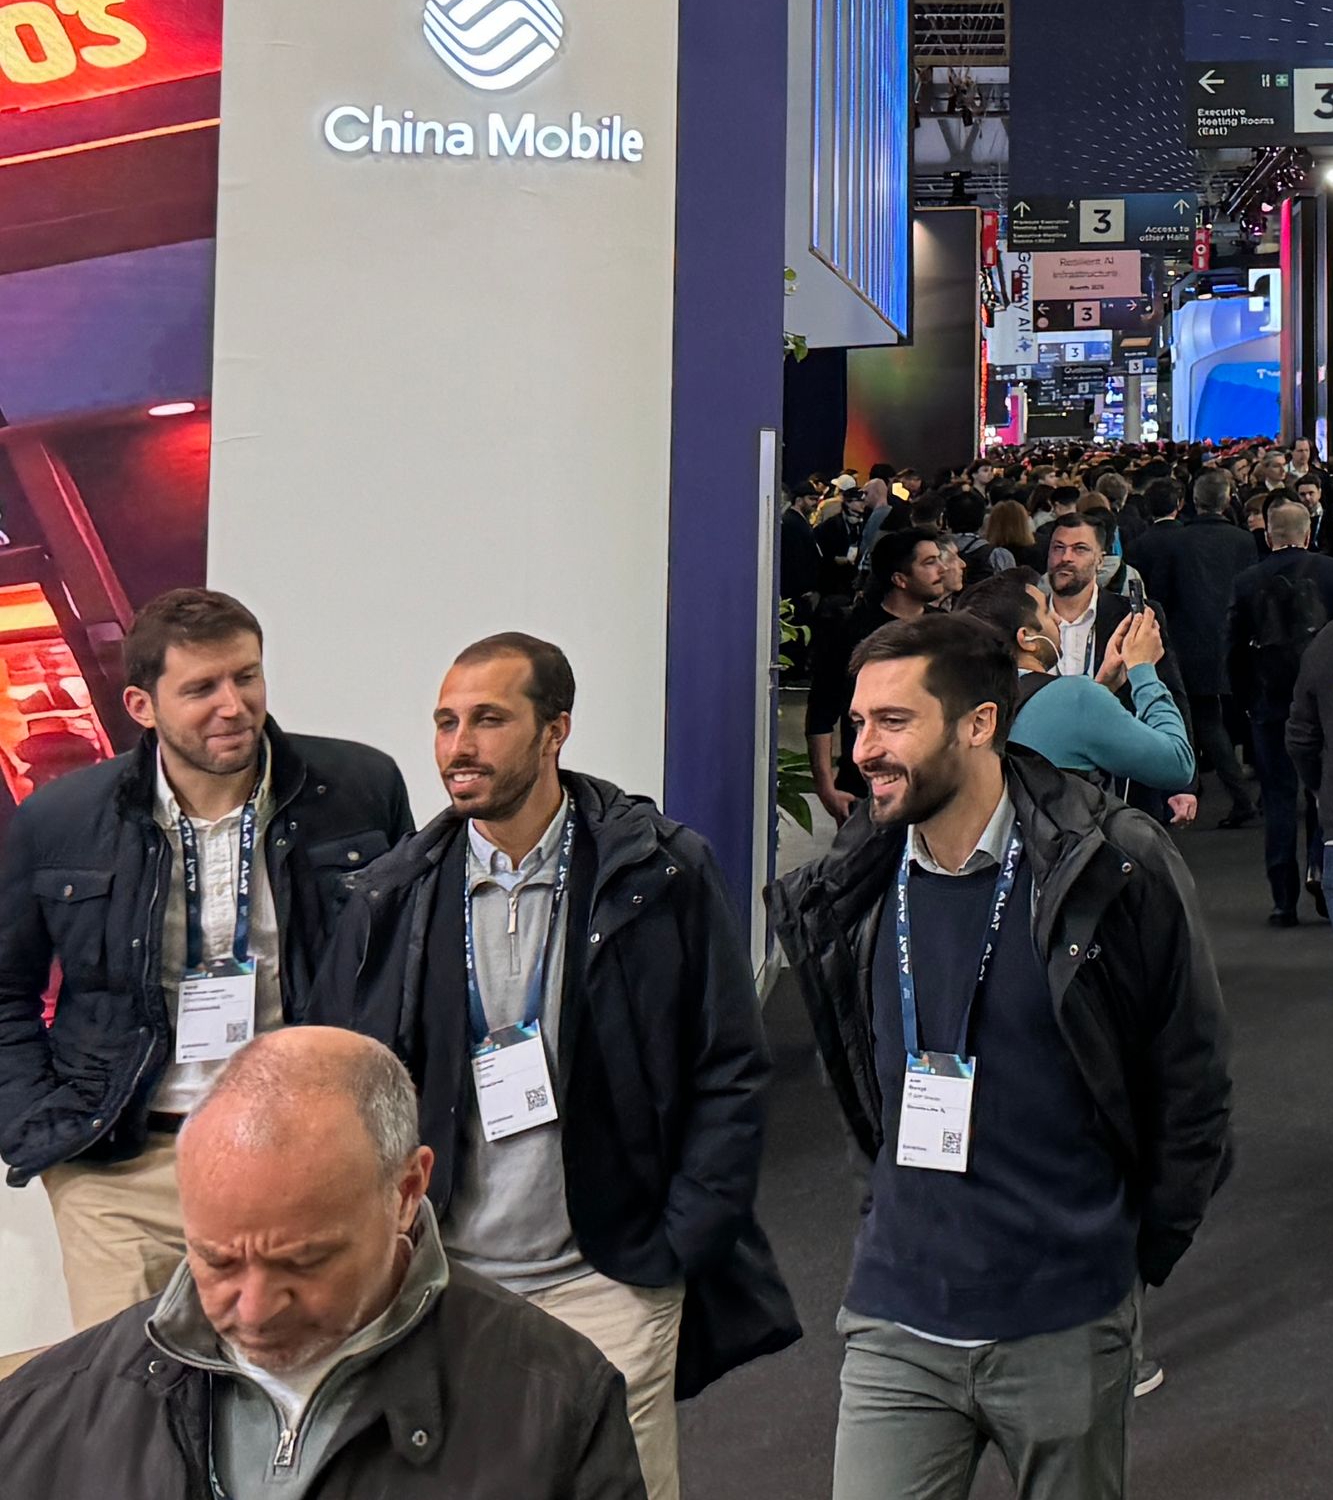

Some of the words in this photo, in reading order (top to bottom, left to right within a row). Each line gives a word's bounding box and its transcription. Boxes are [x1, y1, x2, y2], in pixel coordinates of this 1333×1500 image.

[324, 105, 474, 156] China
[488, 111, 645, 162] Mobile
[1093, 209, 1112, 233] 3
[1081, 307, 1093, 321] 3
